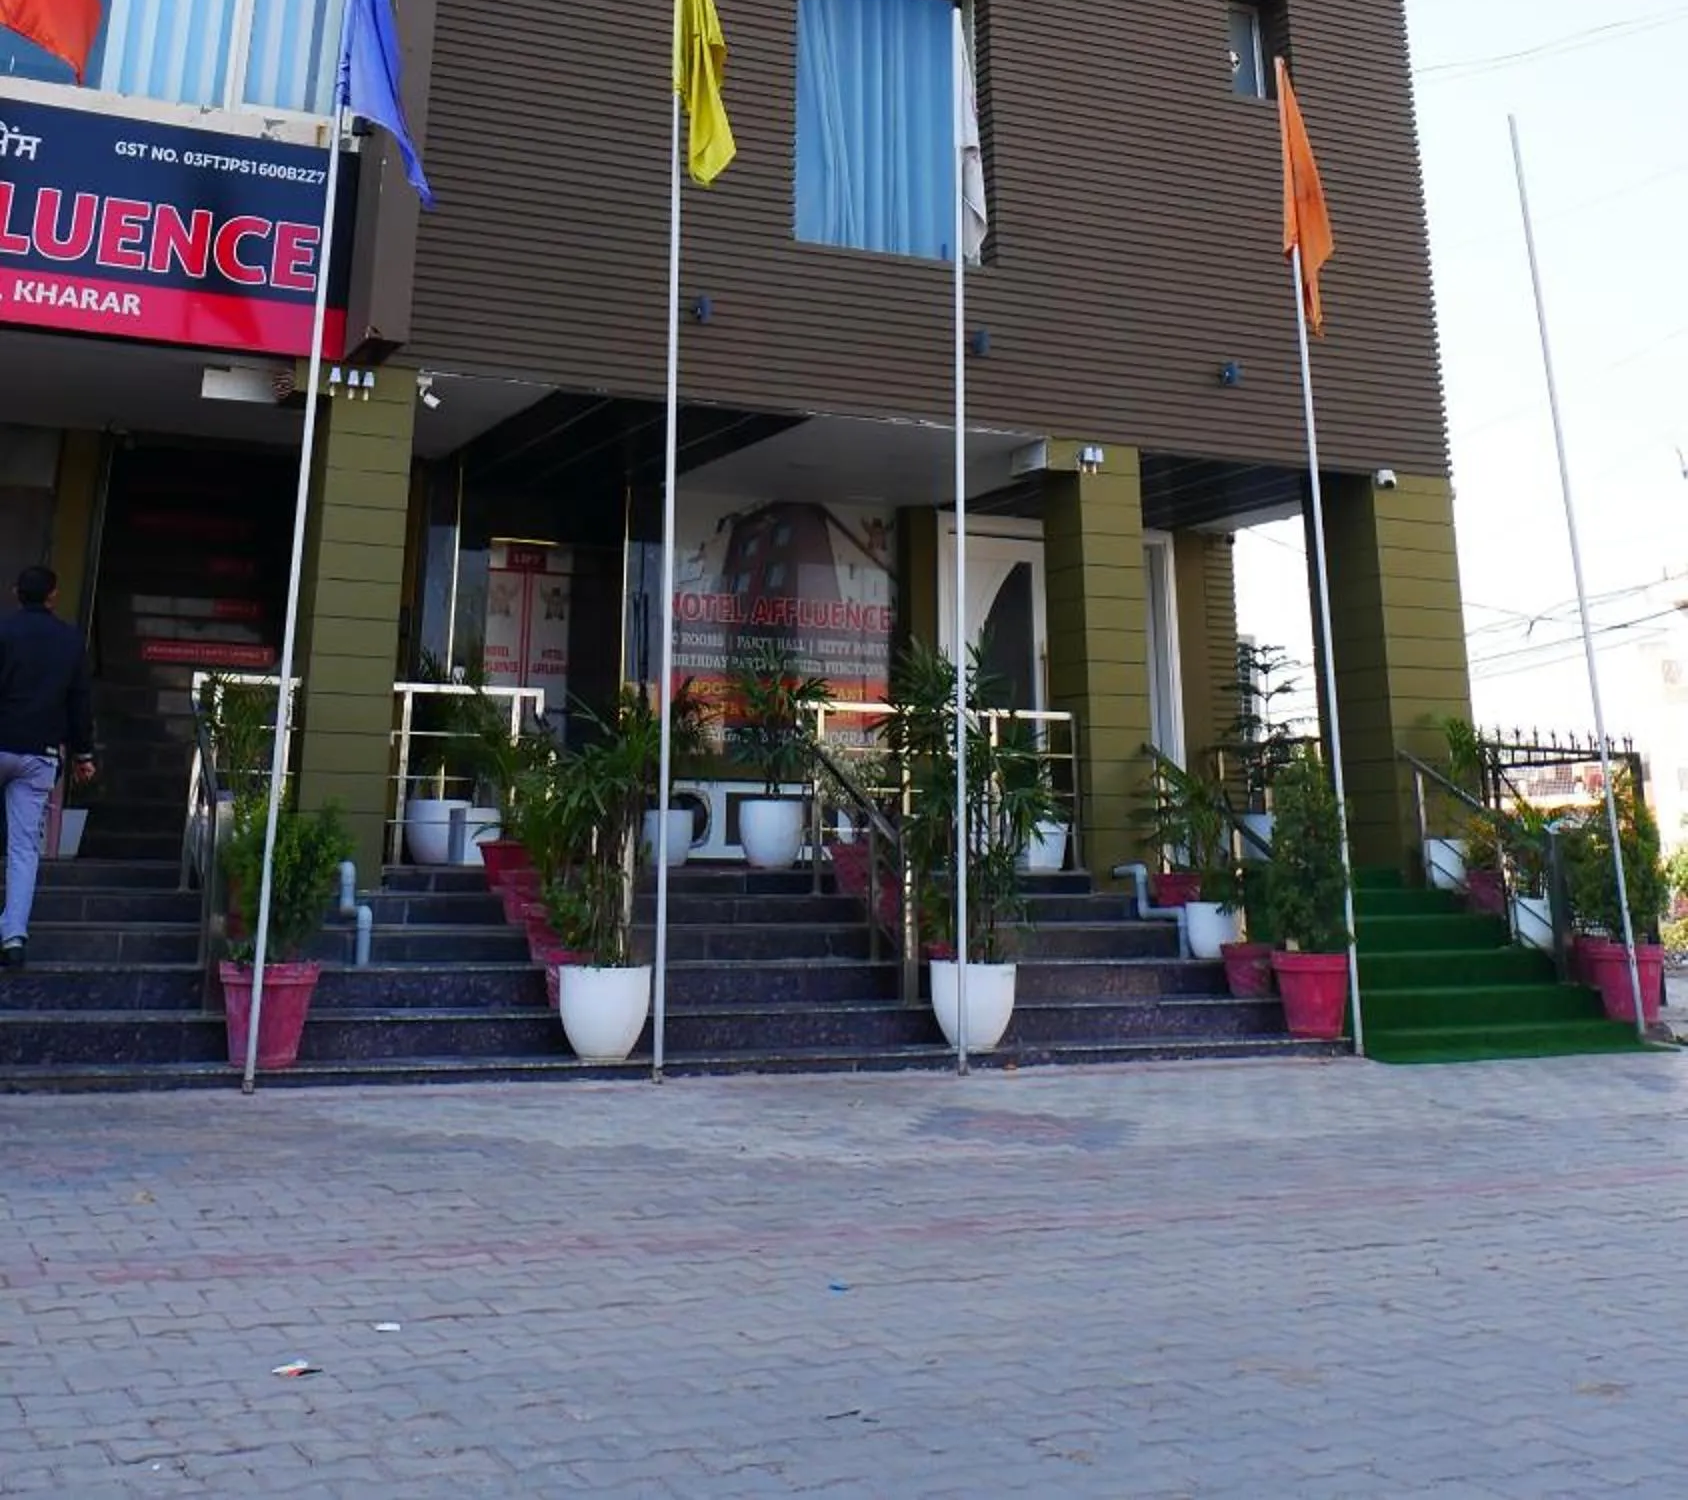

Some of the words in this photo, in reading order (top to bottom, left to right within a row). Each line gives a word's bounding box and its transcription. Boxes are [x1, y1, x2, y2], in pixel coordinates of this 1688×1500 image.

[115, 141, 148, 158] GST
[151, 146, 179, 164] NO.
[14, 280, 141, 316] KHARAR
[750, 597, 893, 632] AFFLUENCE
